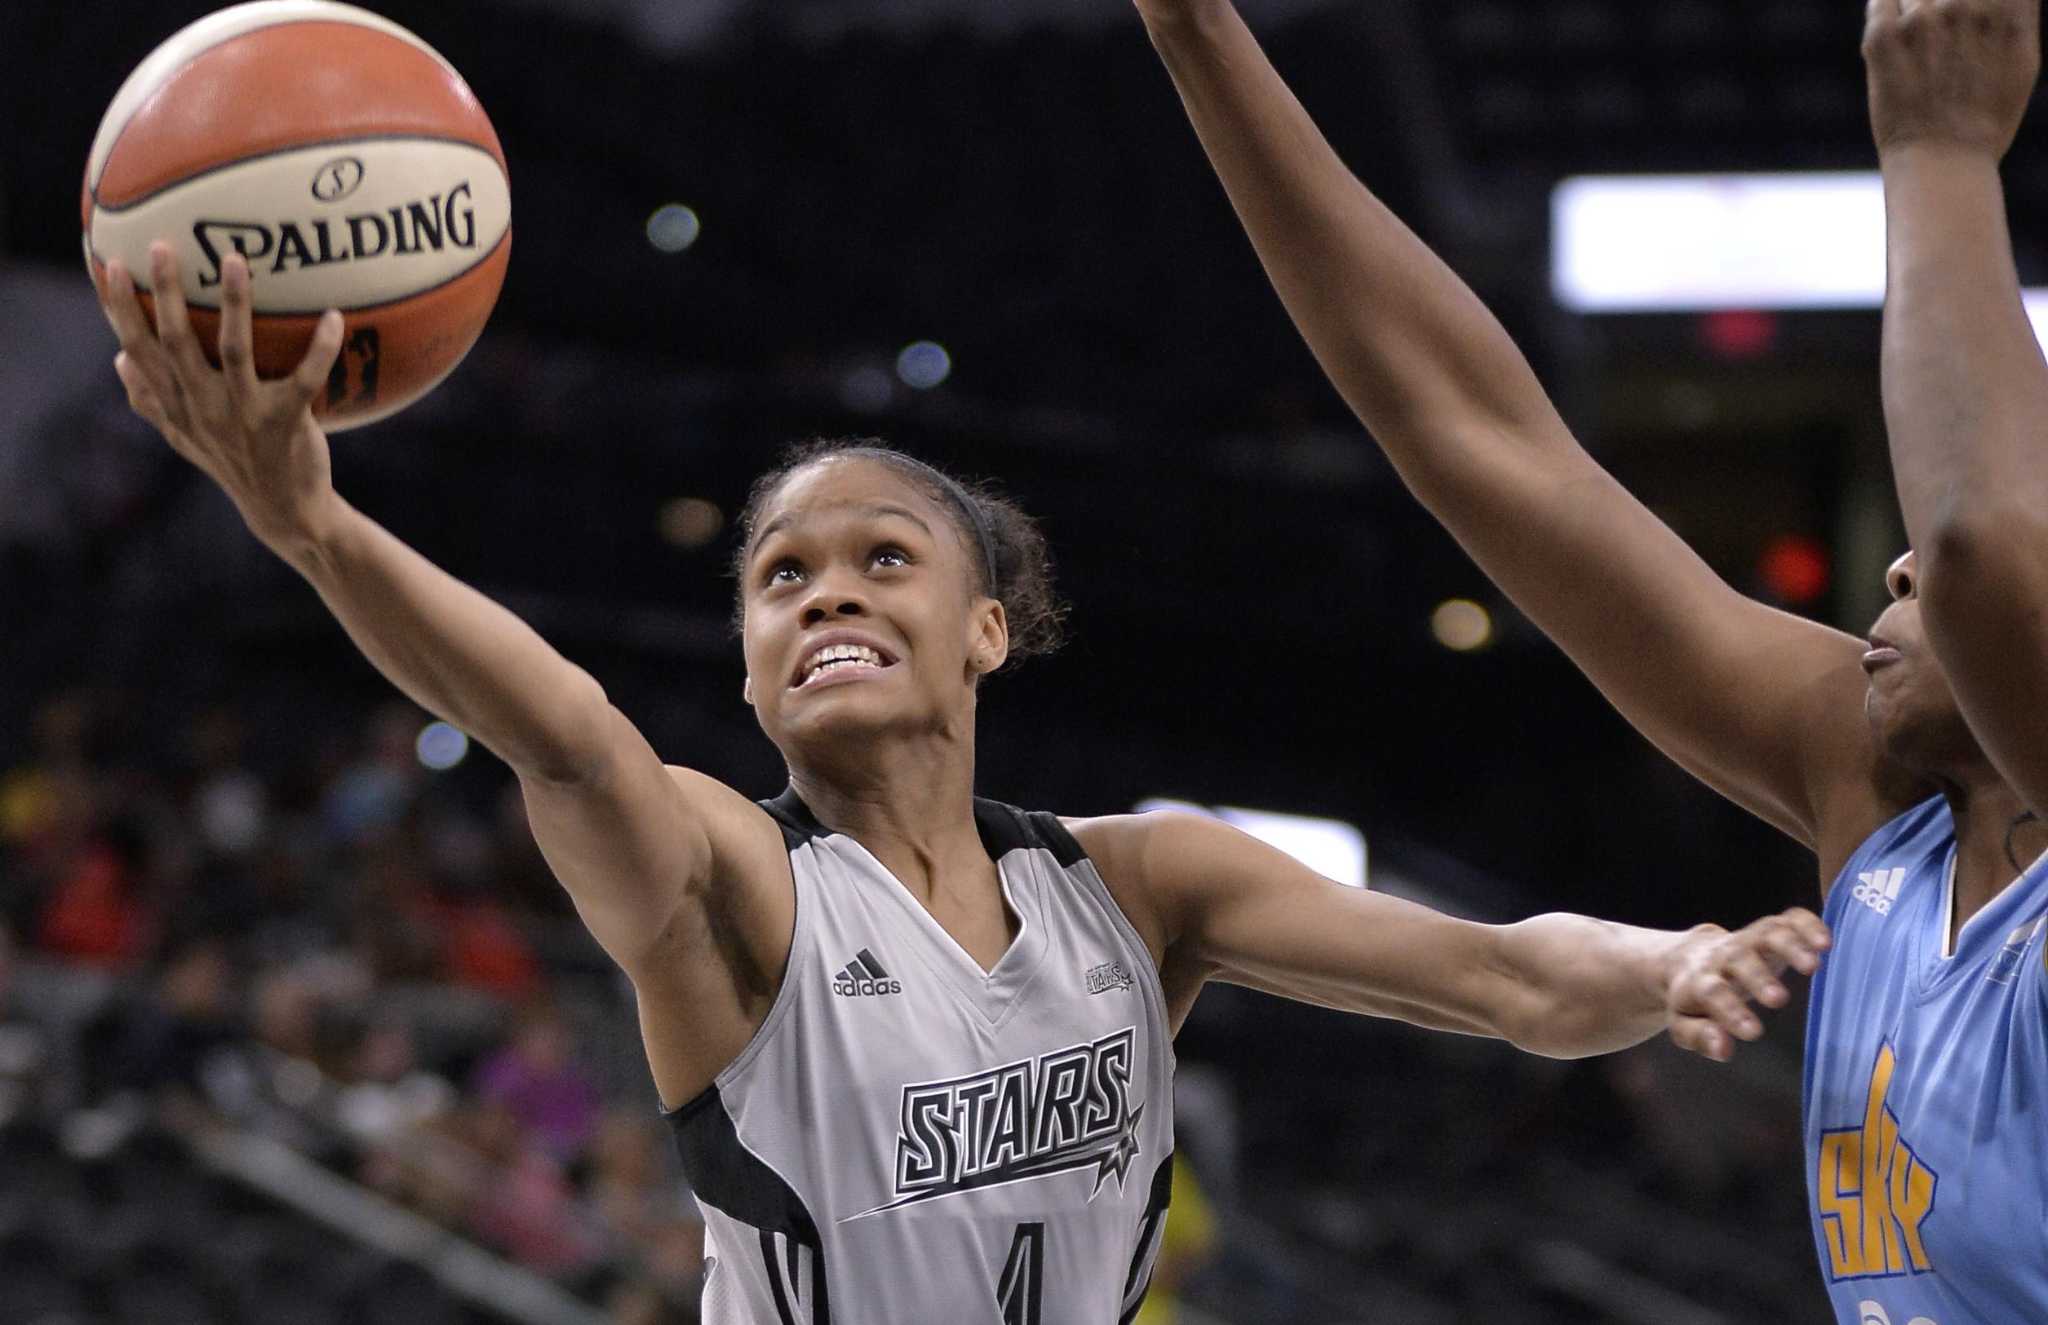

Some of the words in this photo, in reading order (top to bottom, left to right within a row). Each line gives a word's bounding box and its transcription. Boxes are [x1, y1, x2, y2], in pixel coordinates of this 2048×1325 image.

[193, 181, 476, 289] SPALDING
[833, 979, 902, 997] adidas
[897, 1028, 1135, 1194] STARS
[1819, 1036, 1939, 1282] SKY
